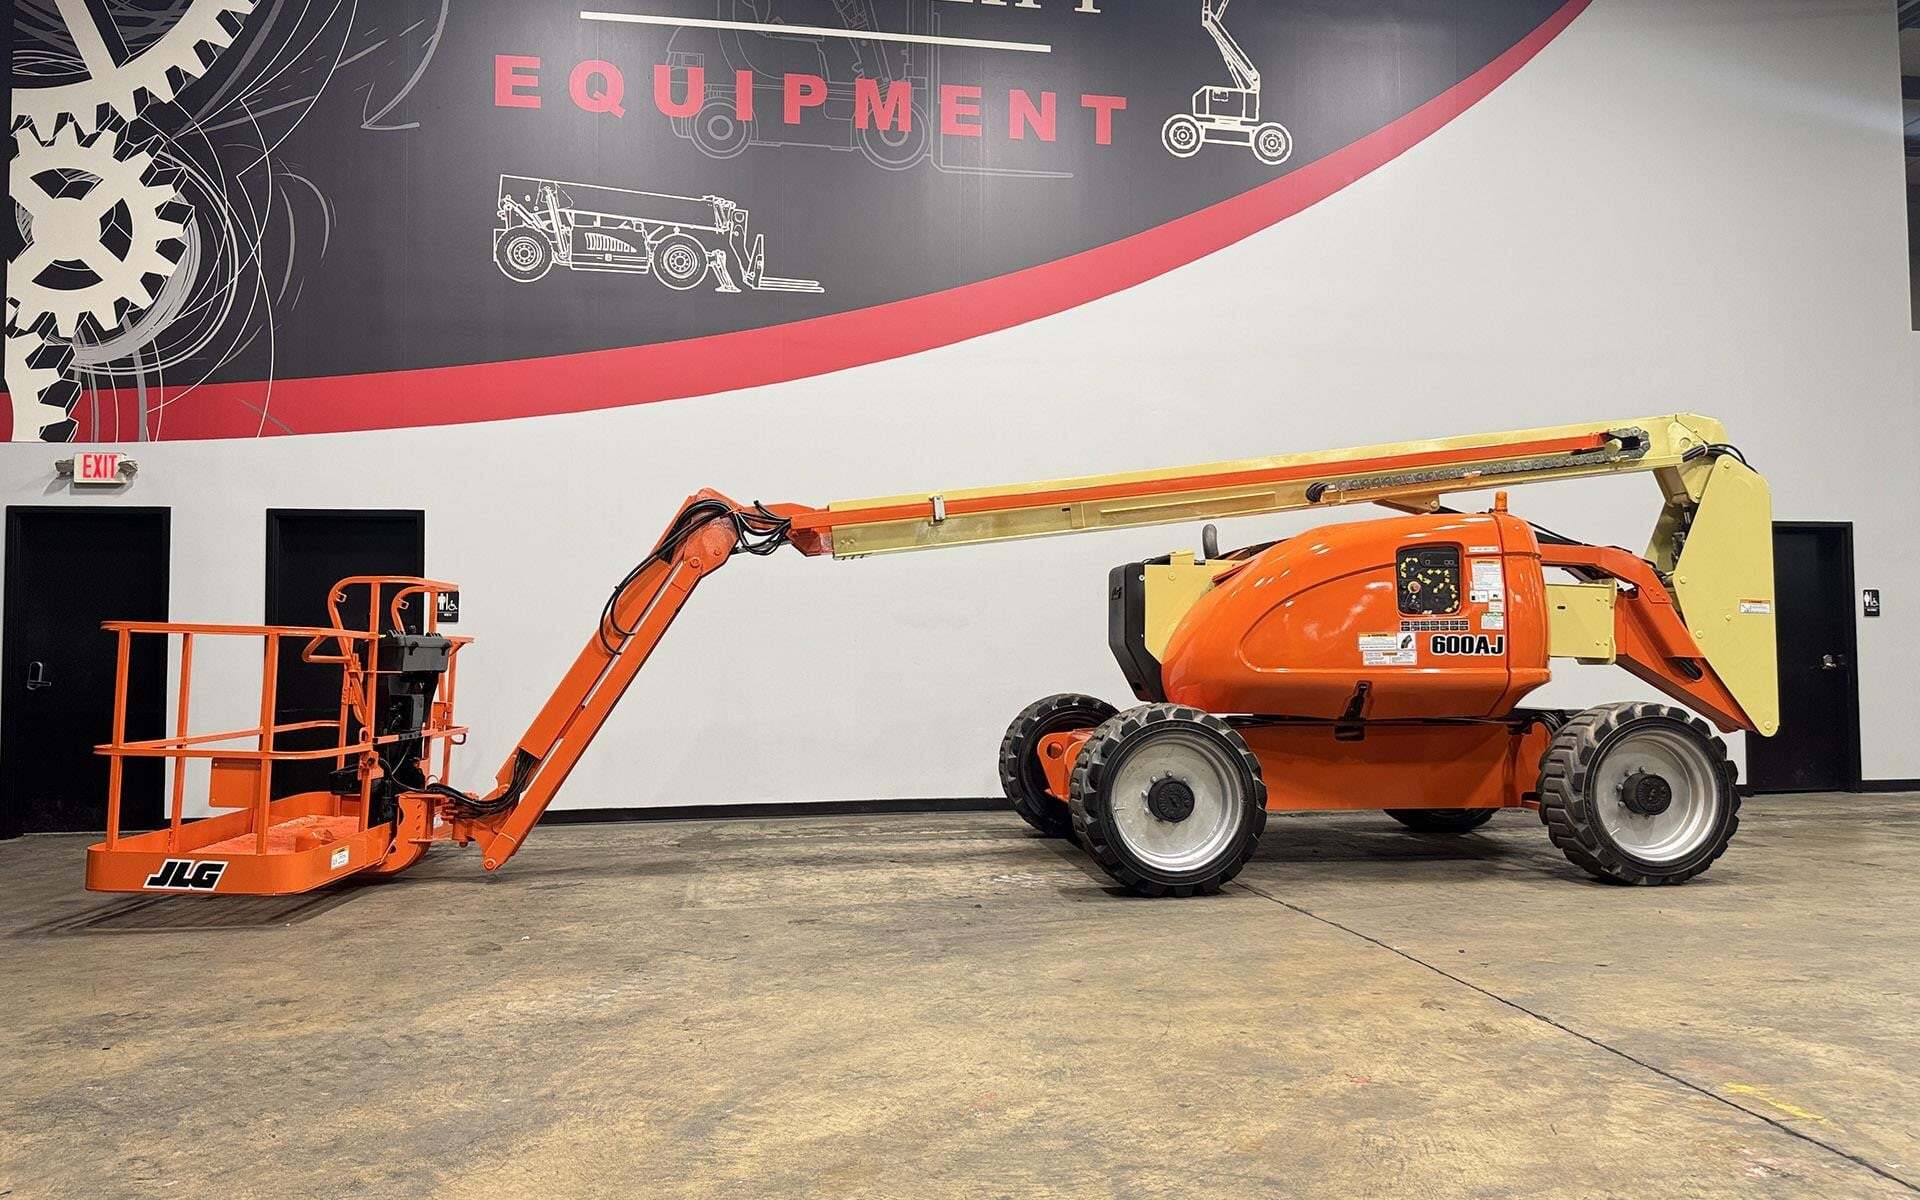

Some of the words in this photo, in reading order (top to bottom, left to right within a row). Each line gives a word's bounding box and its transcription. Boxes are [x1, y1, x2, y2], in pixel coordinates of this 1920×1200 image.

[494, 54, 1127, 145] EQUIPMENT
[82, 454, 117, 479] EXIT
[1432, 635, 1503, 655] 600AJ
[146, 860, 226, 889] JLG
